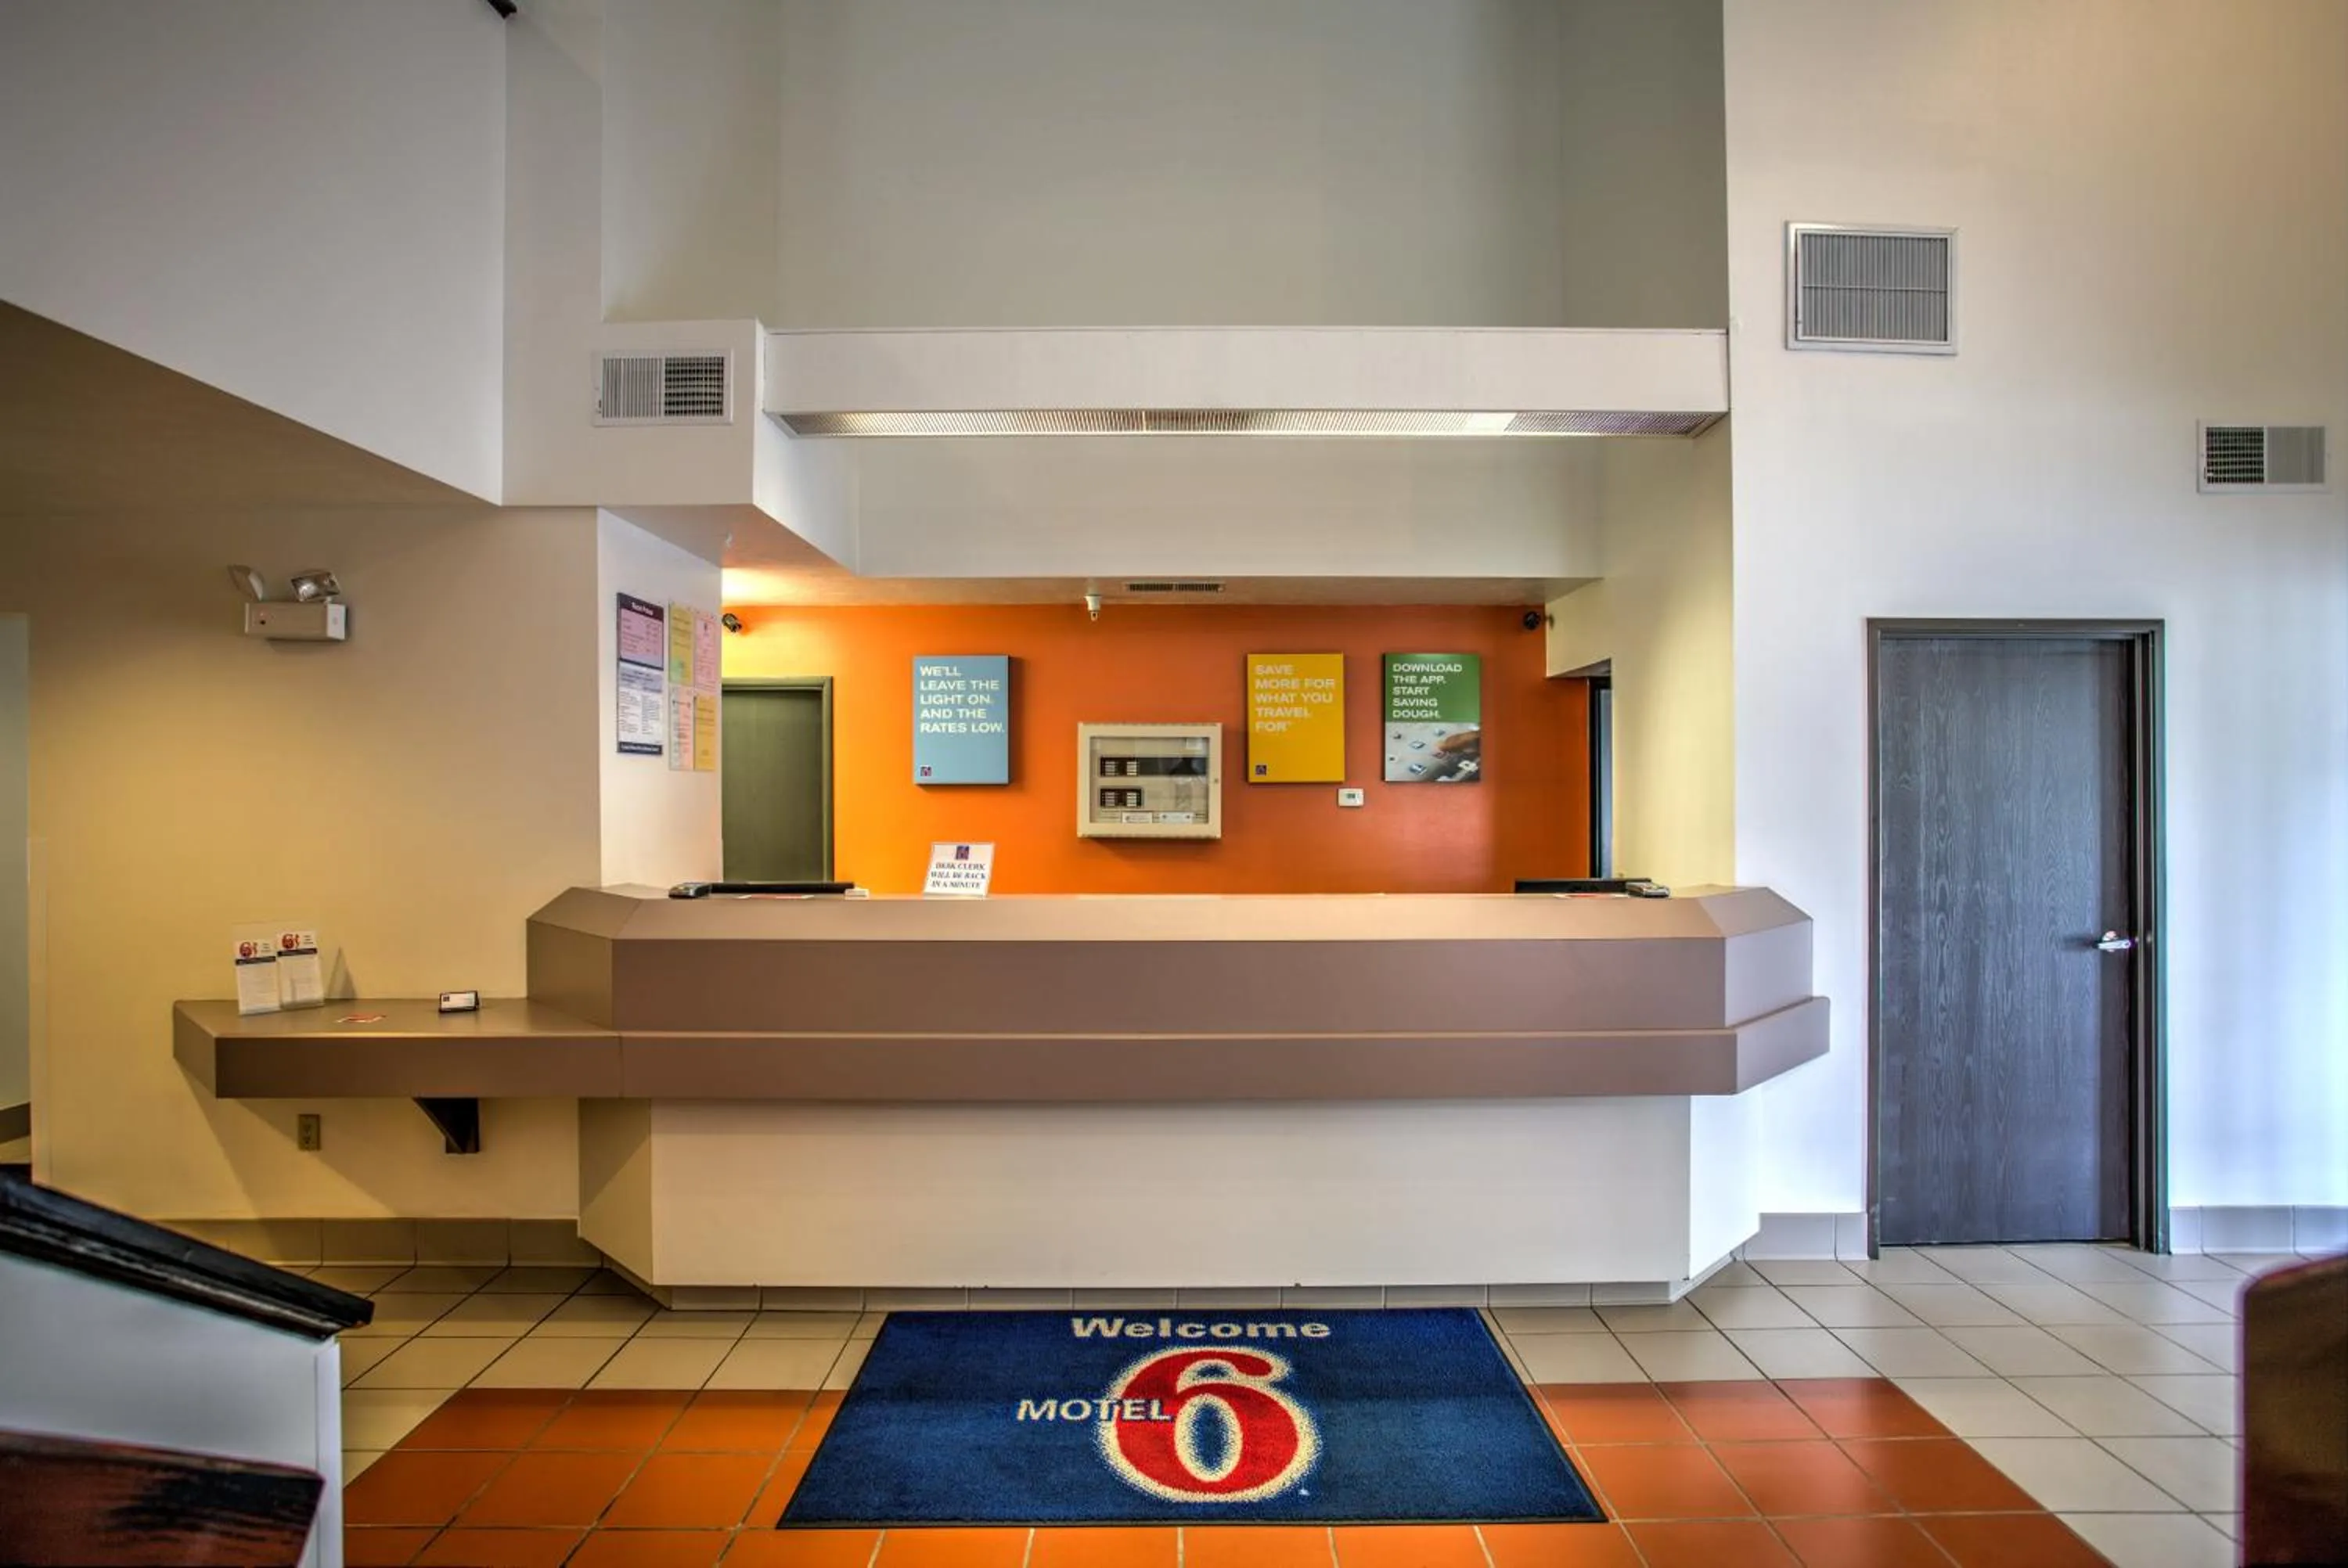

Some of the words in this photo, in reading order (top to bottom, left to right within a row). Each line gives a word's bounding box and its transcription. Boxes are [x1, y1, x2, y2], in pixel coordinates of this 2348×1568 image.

[1255, 664, 1293, 675] SAVE
[1392, 663, 1463, 673] DOWNLOAD
[920, 680, 966, 690] LEAVE
[971, 680, 1000, 690] THE
[1255, 678, 1299, 689] MORE
[1304, 678, 1335, 689] FOR
[1392, 675, 1417, 684] THE
[1420, 675, 1447, 685] APP.
[1392, 686, 1430, 696] START
[920, 694, 963, 705] LIGHT
[1255, 692, 1297, 703] WHAT
[1302, 692, 1334, 703] YOU
[1392, 697, 1438, 707] SAVING
[920, 708, 953, 719] AND
[956, 708, 987, 719] THE
[1255, 707, 1312, 718] TRAVEL
[920, 722, 967, 733] RATES
[971, 722, 1005, 733] LOW.
[1071, 1318, 1331, 1338] Welcome
[1017, 1398, 1174, 1422] MOTEL
[1099, 1345, 1321, 1502] 6
